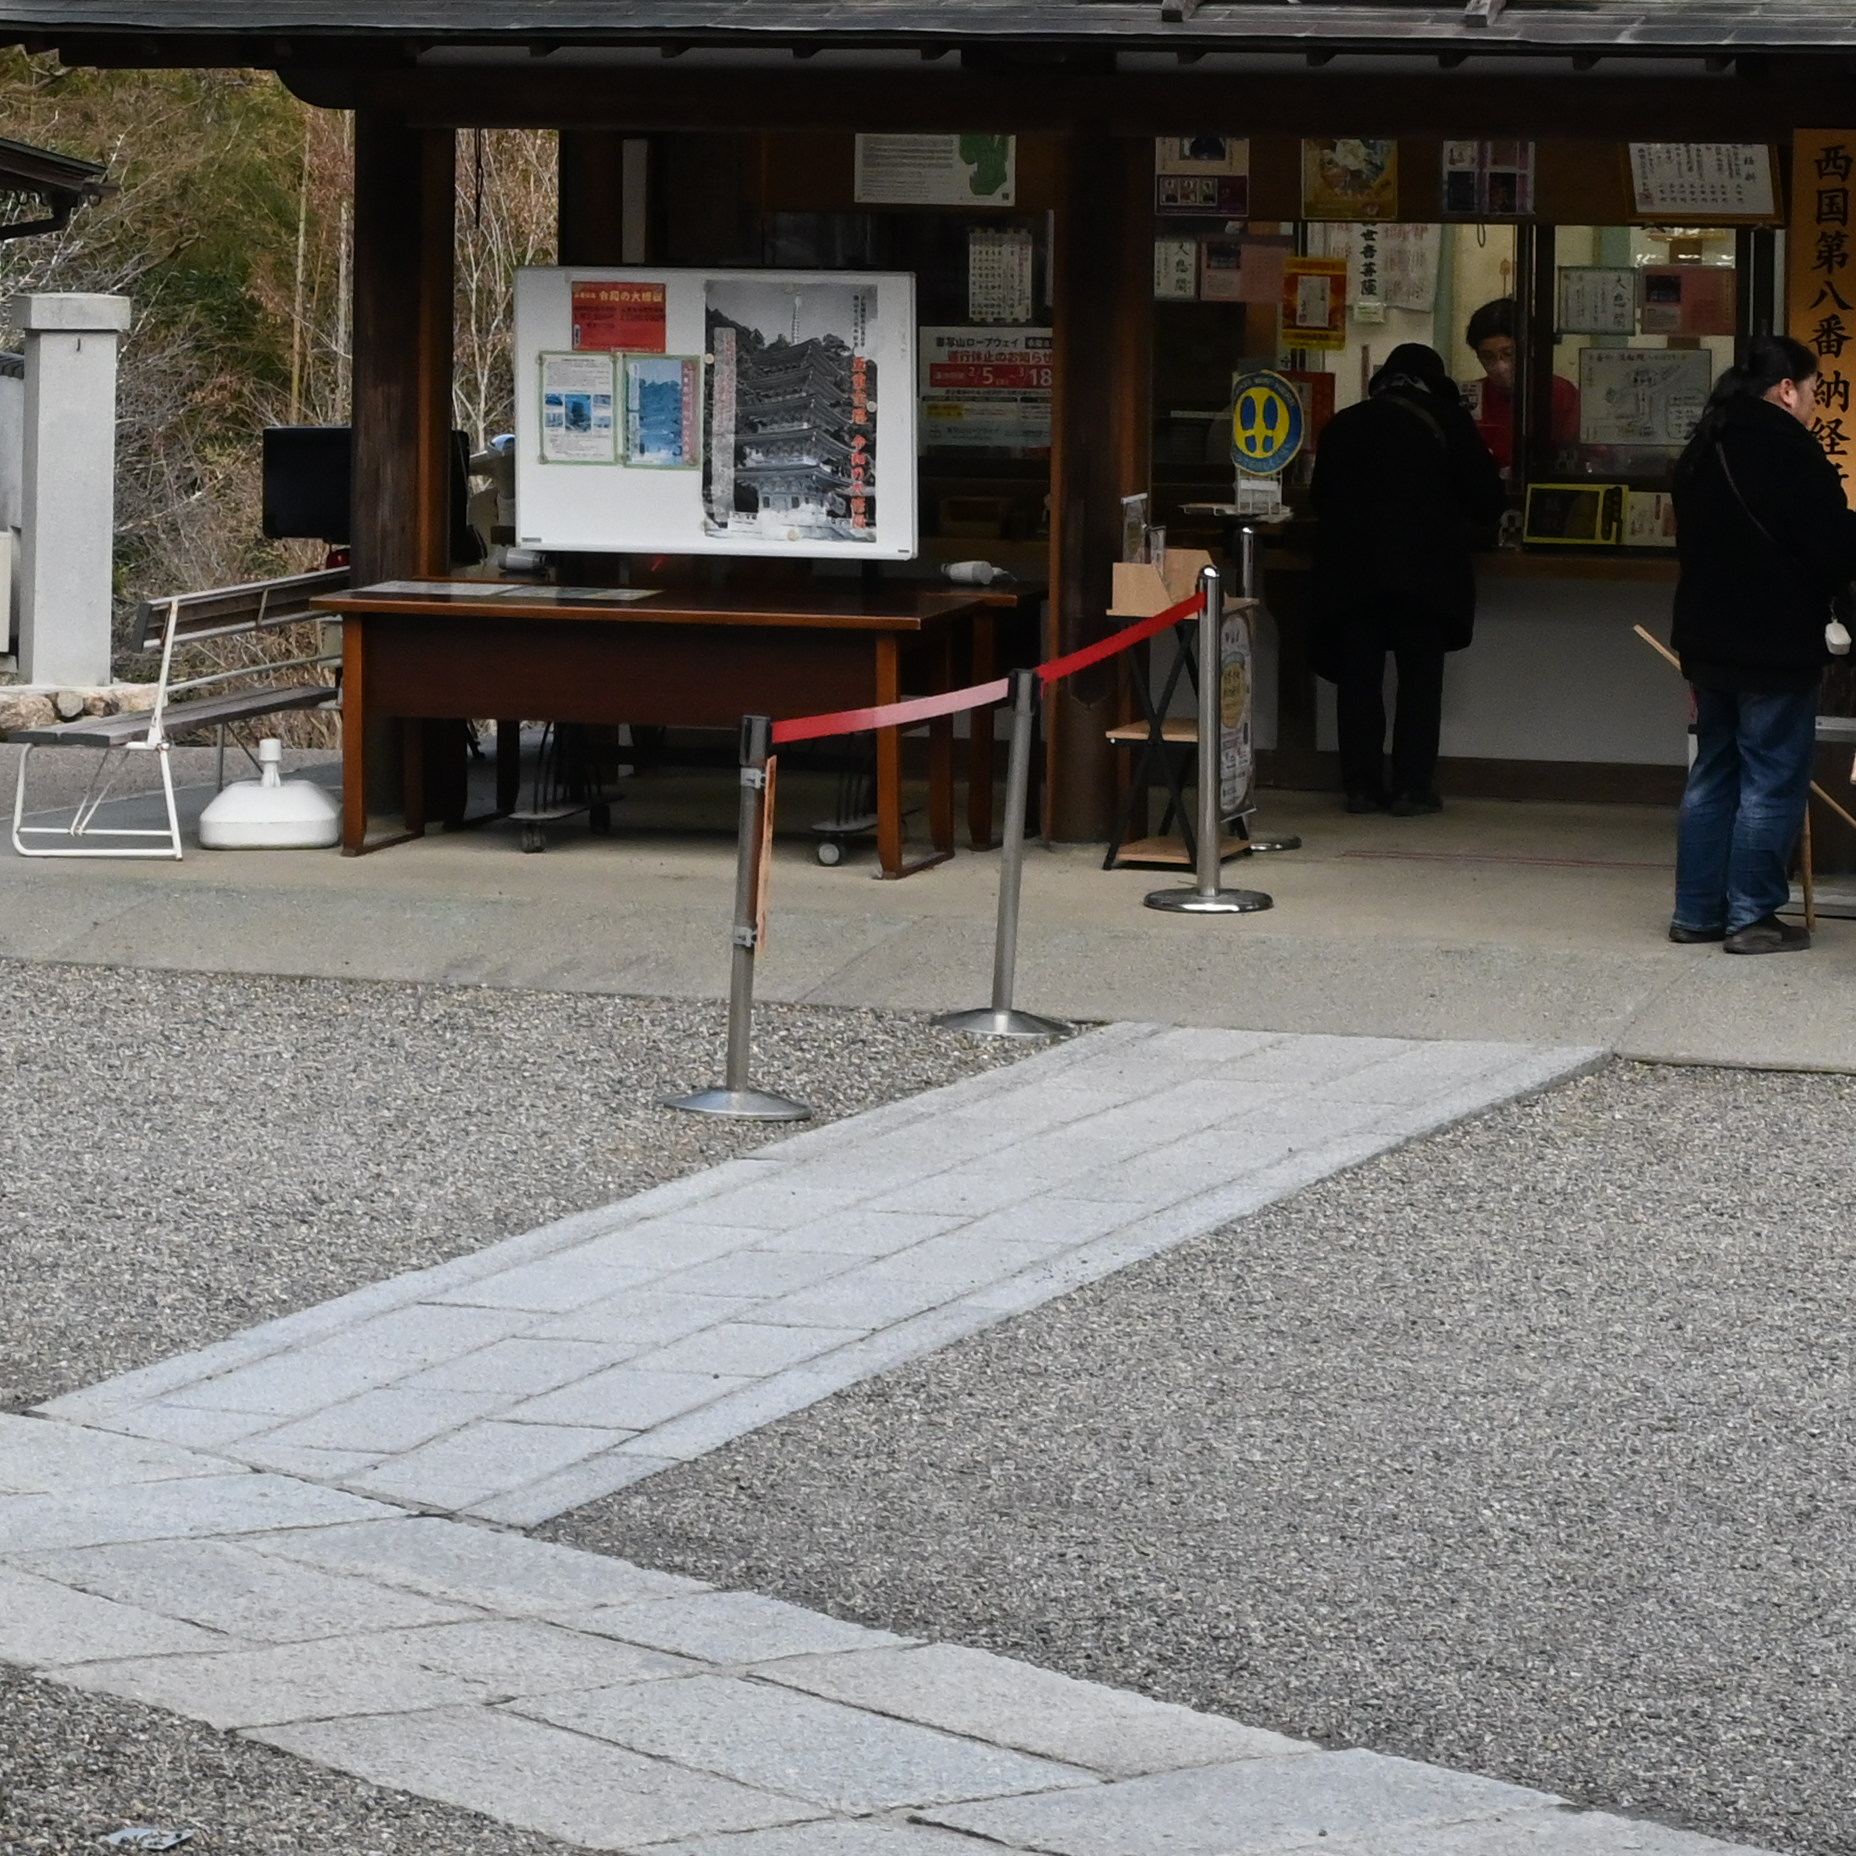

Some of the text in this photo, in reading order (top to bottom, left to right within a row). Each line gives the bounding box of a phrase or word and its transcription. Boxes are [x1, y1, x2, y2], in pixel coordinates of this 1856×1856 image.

[1359, 220, 1378, 297] 世音菩薩
[1808, 145, 1854, 479] 西国第八番納経
